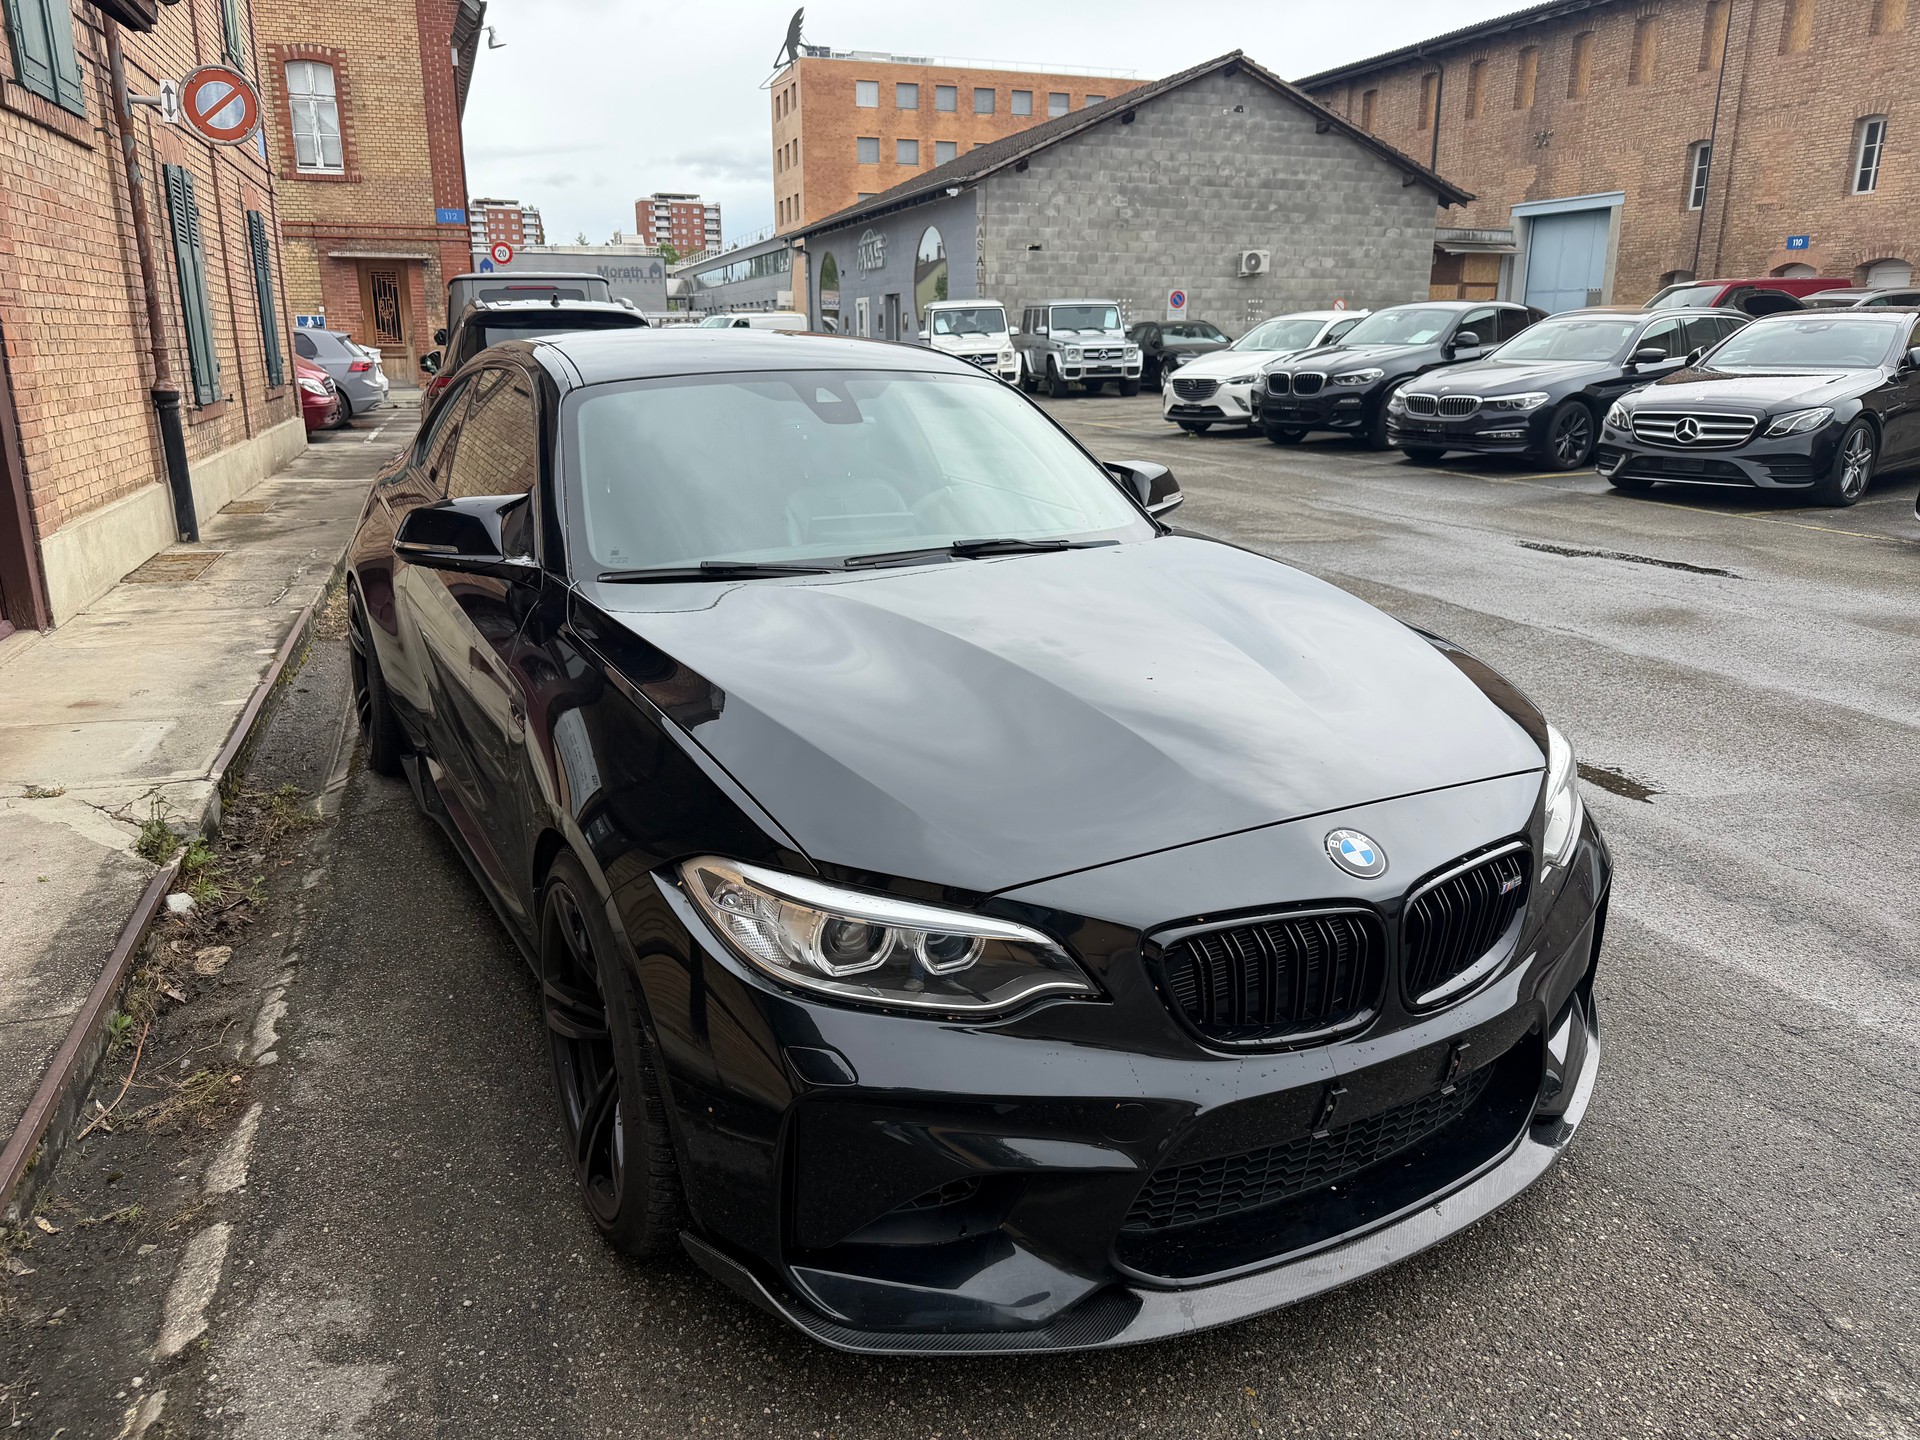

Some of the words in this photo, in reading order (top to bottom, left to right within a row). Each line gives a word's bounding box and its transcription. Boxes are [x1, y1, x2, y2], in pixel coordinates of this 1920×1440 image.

[444, 211, 458, 221] 112
[976, 215, 985, 251] MAS
[1792, 238, 1803, 247] 110
[497, 249, 507, 258] 20
[596, 265, 644, 278] Morath
[976, 255, 985, 298] AUT
[1329, 830, 1369, 849] BMW
